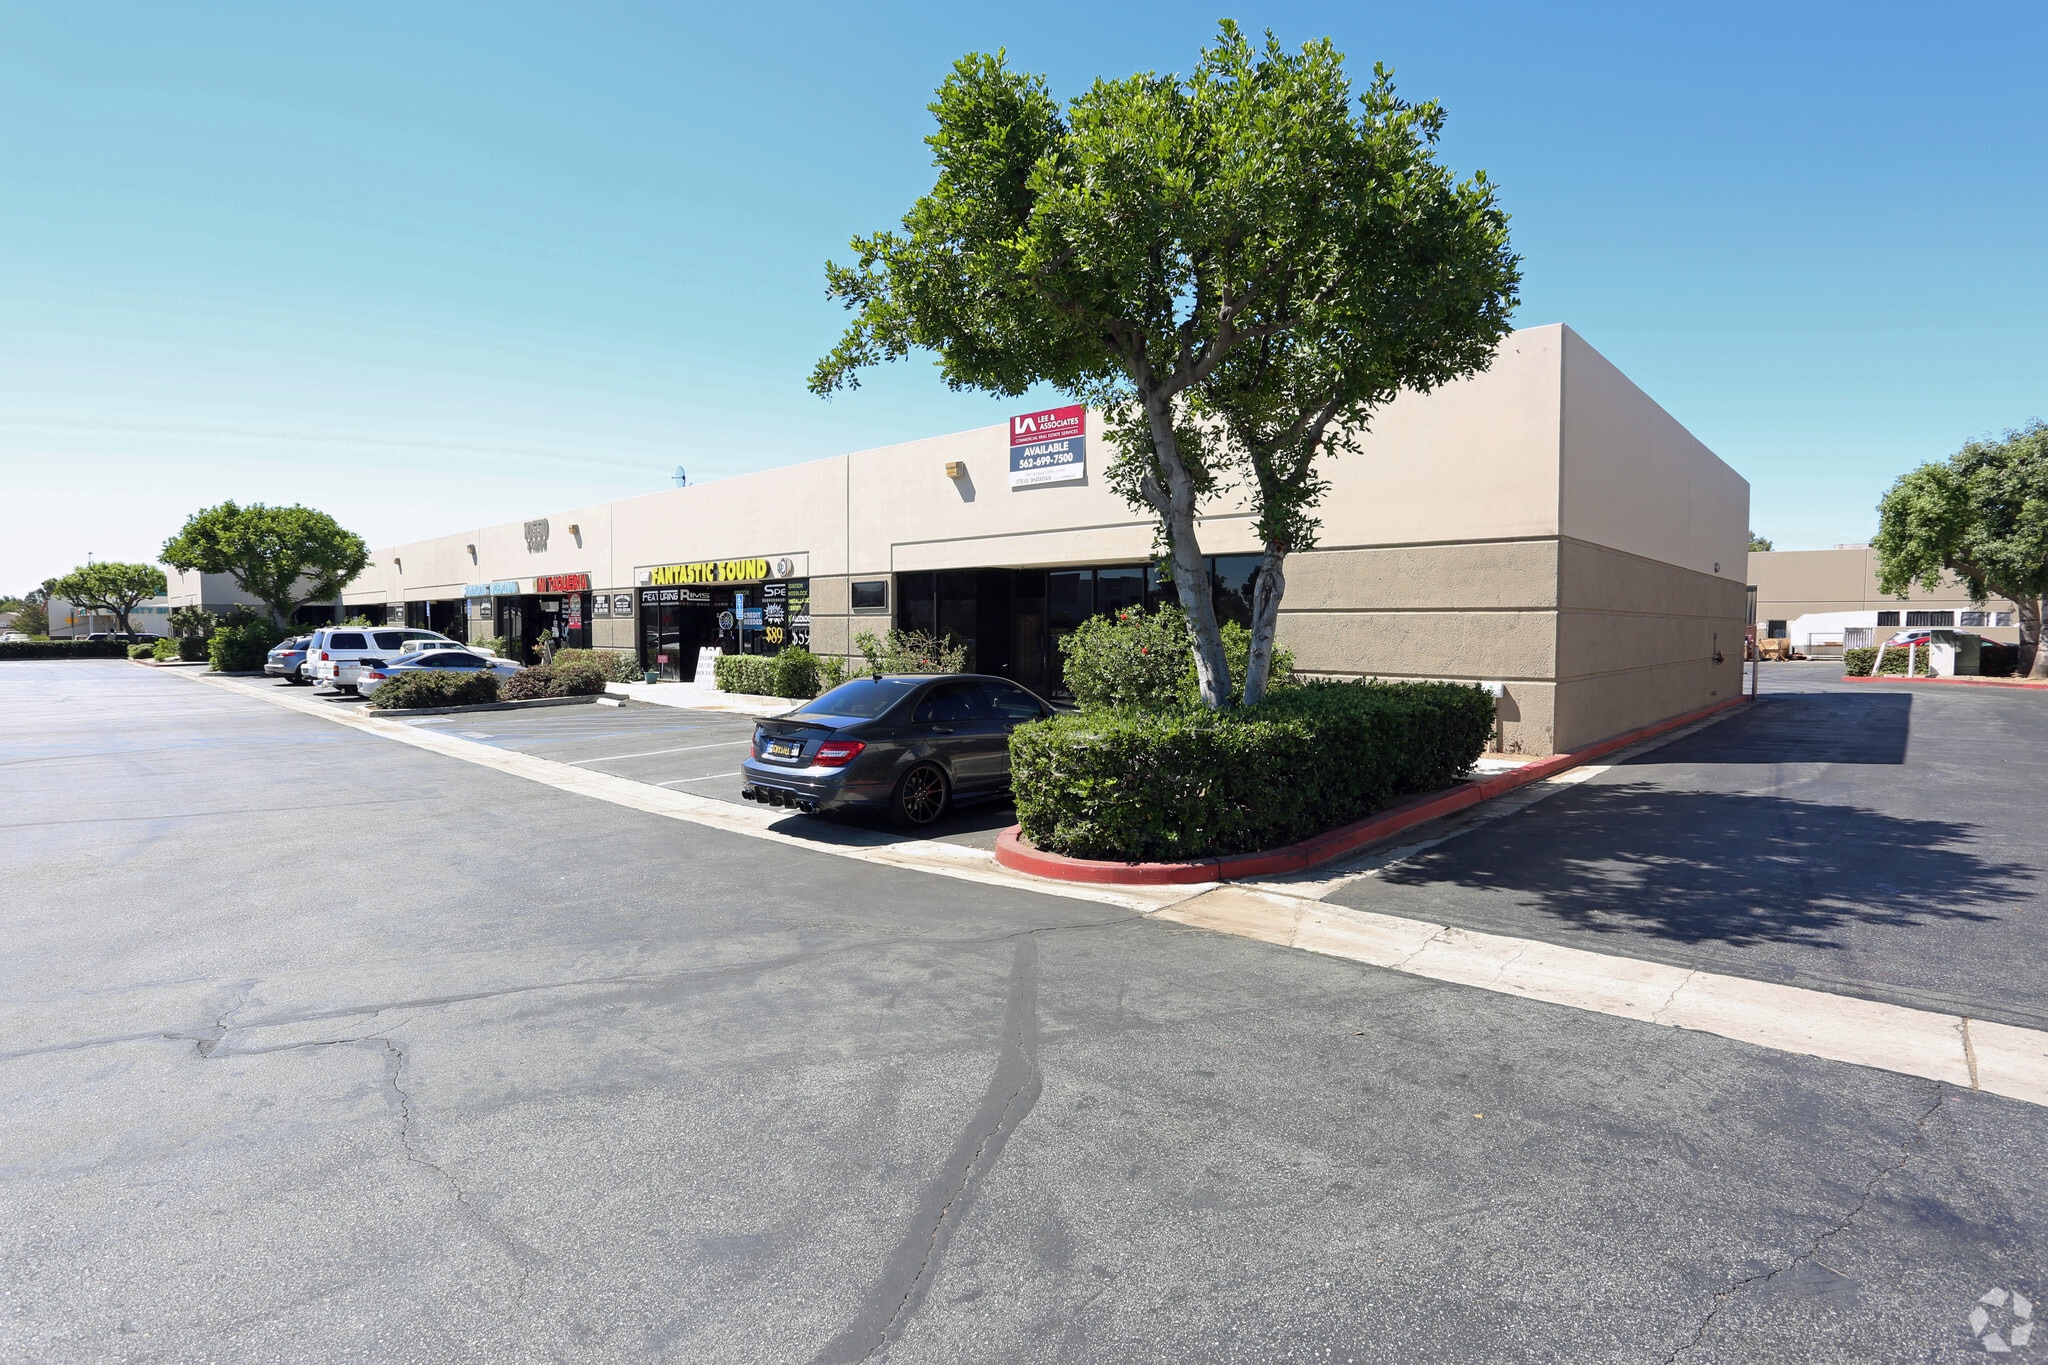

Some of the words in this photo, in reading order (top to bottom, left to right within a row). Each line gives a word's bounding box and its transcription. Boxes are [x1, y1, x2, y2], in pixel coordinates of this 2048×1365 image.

[1038, 415, 1049, 423] LEE
[1040, 417, 1078, 430] ASSOCIATES
[1015, 435, 1038, 443] COMMERCIAL
[1024, 441, 1069, 457] AVAILABLE
[1019, 452, 1073, 469] 562-699-7500
[651, 563, 714, 585] FANTASTIC
[717, 558, 767, 581] SOUND
[547, 574, 587, 592] TAQUERIA
[680, 588, 710, 601] RIMS
[766, 626, 783, 644] $89
